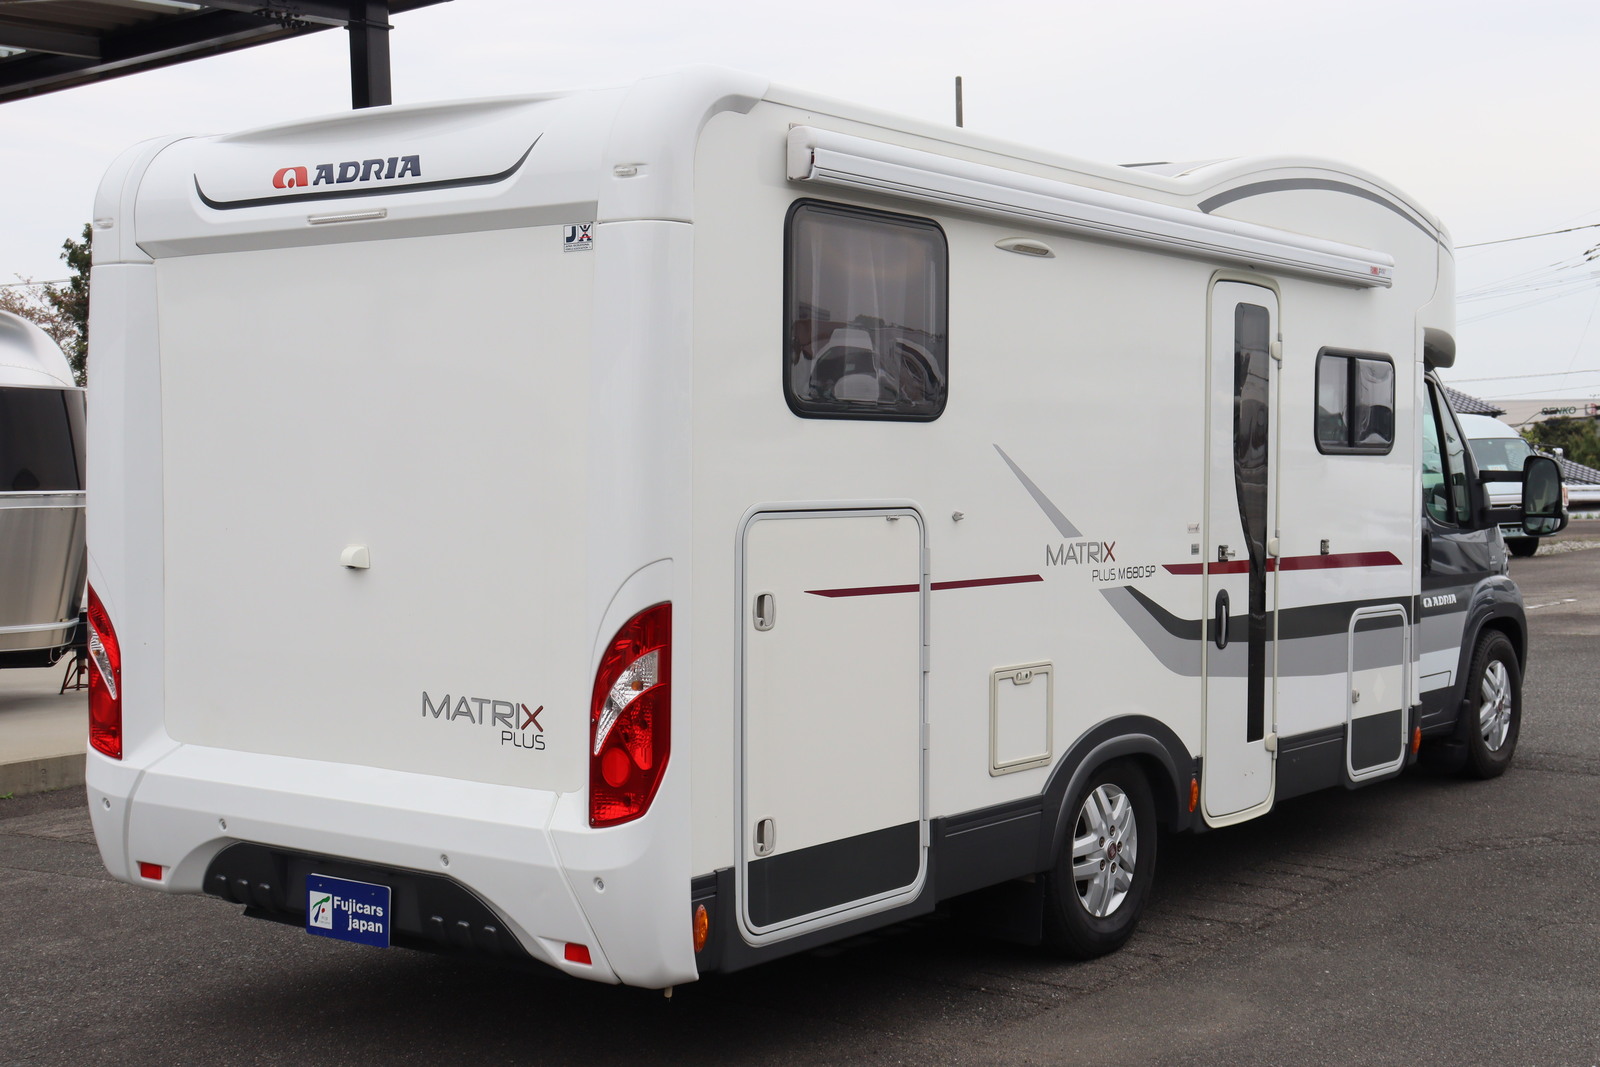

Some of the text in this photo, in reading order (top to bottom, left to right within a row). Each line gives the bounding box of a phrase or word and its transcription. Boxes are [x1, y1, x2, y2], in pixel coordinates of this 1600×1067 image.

[313, 154, 422, 186] ADRIA
[1045, 541, 1116, 567] MATRIX
[1091, 568, 1117, 583] PLUS
[1432, 593, 1457, 607] ADRIA
[422, 691, 544, 732] MATRIX
[501, 730, 546, 751] PLUS
[333, 896, 384, 917] Fujicars
[347, 915, 383, 934] japan
